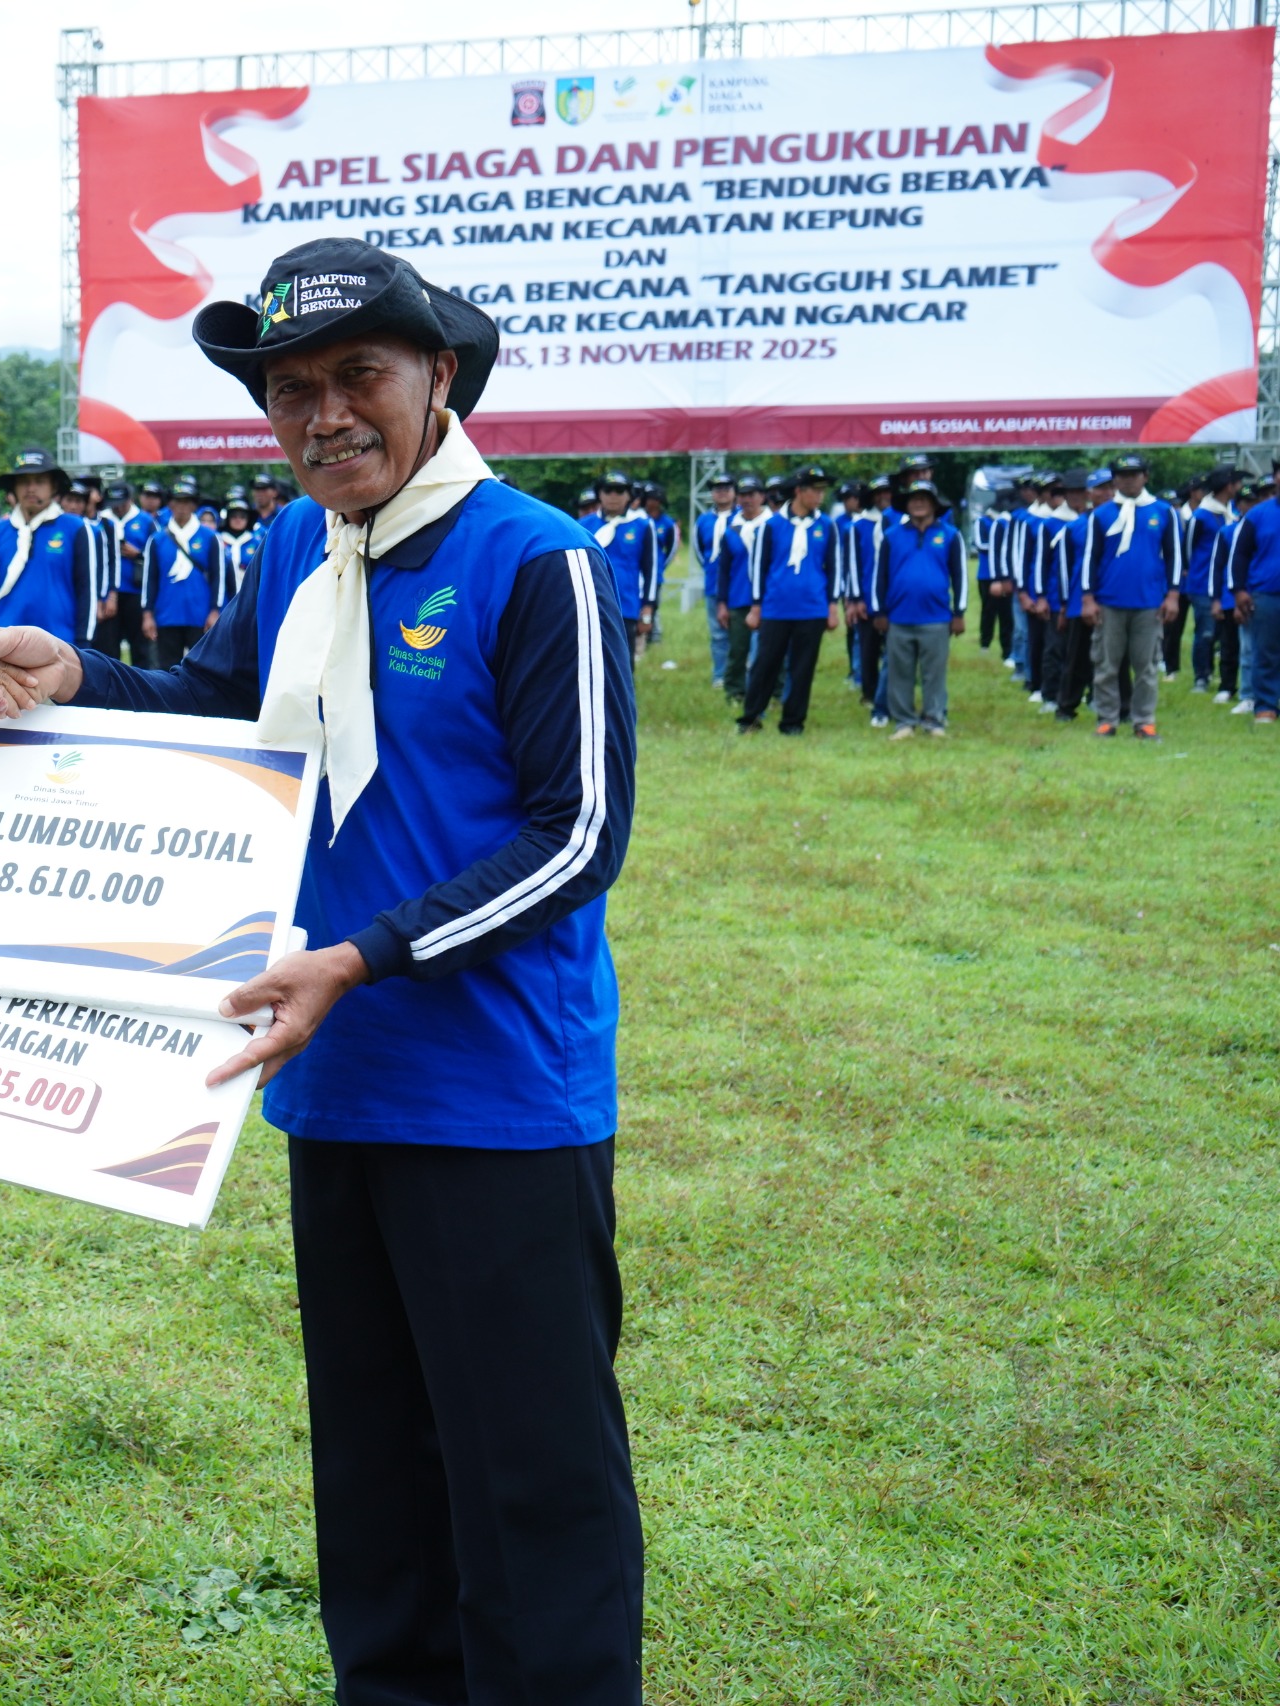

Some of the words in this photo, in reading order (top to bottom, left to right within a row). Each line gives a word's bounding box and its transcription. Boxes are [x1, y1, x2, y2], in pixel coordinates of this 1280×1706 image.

[708, 75, 769, 89] KAMPUNG
[708, 91, 744, 100] SIAGA
[708, 102, 764, 114] BENCANA
[277, 155, 388, 189] APEL
[401, 145, 542, 182] SIAGA
[556, 140, 659, 175] DAN
[673, 122, 1030, 169] PENGUKUHAN
[241, 195, 405, 224] KAMPUNG
[414, 189, 515, 216] SIAGA
[525, 181, 691, 211] BENCANA
[365, 226, 443, 248] DESA
[453, 221, 553, 245] SIMAN
[563, 211, 774, 241] KECAMATAN
[783, 206, 924, 232] KEPUNG
[604, 248, 667, 269] DAN
[300, 273, 367, 288] KAMPUNG
[448, 283, 516, 304] AGA
[524, 276, 691, 304] BENCANA
[300, 287, 342, 301] SIAGA
[300, 299, 363, 315] BENCANA
[576, 306, 785, 333] KECAMATAN
[795, 300, 968, 326] NGANCAR
[540, 346, 570, 367] 13
[580, 340, 753, 365] NOVEMBER
[761, 337, 837, 361] 2025
[880, 419, 927, 435] DINAS
[930, 418, 982, 434] SOSIAL
[983, 416, 1078, 432] KABUPATEN
[1080, 415, 1132, 431] KEDIRI
[388, 645, 414, 661] Dinas
[415, 652, 446, 669] Sosial
[14, 793, 49, 803] Provinsi
[51, 797, 73, 805] Jawa
[75, 799, 100, 807] Timur
[33, 785, 57, 794] Dinas
[59, 787, 85, 796] Sosial
[151, 826, 255, 864] SOSIAL
[6, 997, 203, 1058] PERLENGKAPAN
